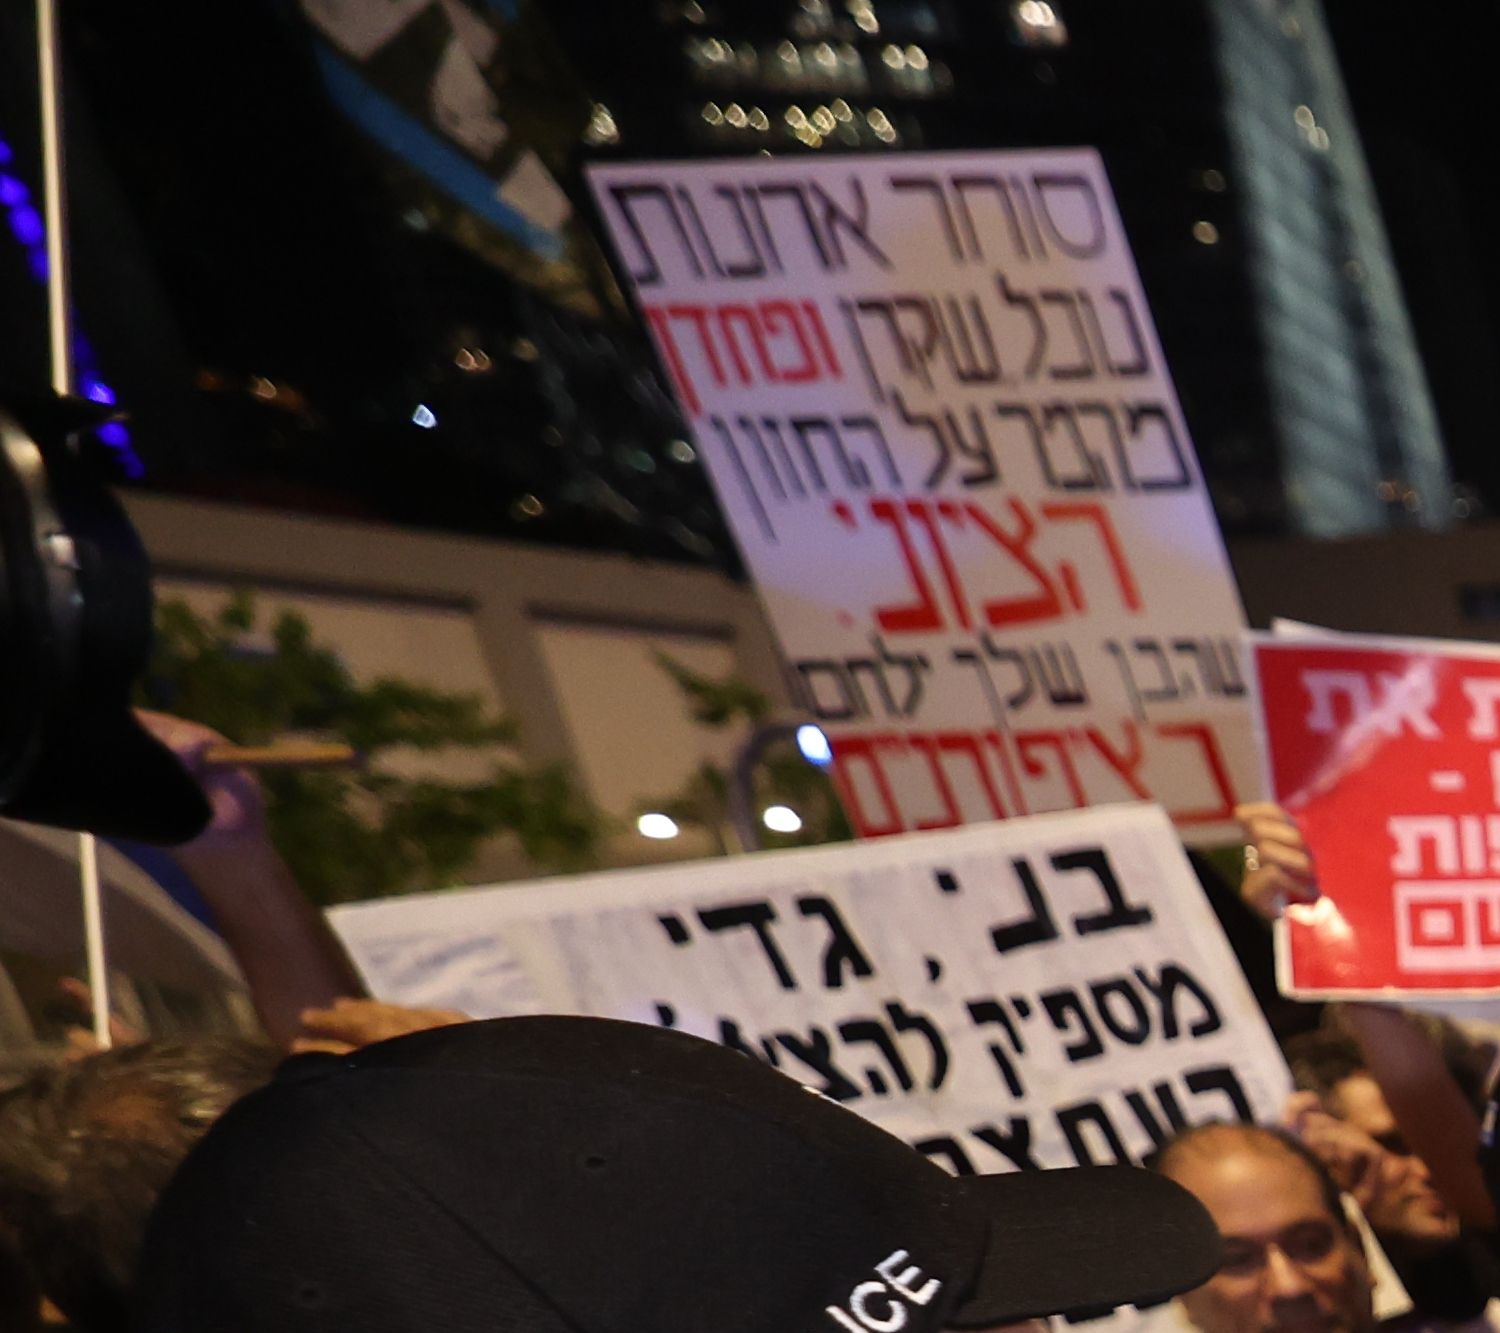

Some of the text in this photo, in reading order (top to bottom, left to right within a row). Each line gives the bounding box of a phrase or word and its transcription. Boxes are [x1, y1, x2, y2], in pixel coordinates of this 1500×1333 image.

[889, 170, 1107, 266] סוחר
[642, 270, 1149, 418] נוכל שקרן ופחדן
[710, 413, 905, 545] החזון
[892, 391, 1004, 490] על
[833, 494, 1145, 633] הציוני
[951, 630, 1090, 731] שלך
[1302, 666, 1442, 739] את
[655, 896, 875, 990] גדי
[718, 960, 1224, 1103] מספיק להצי
